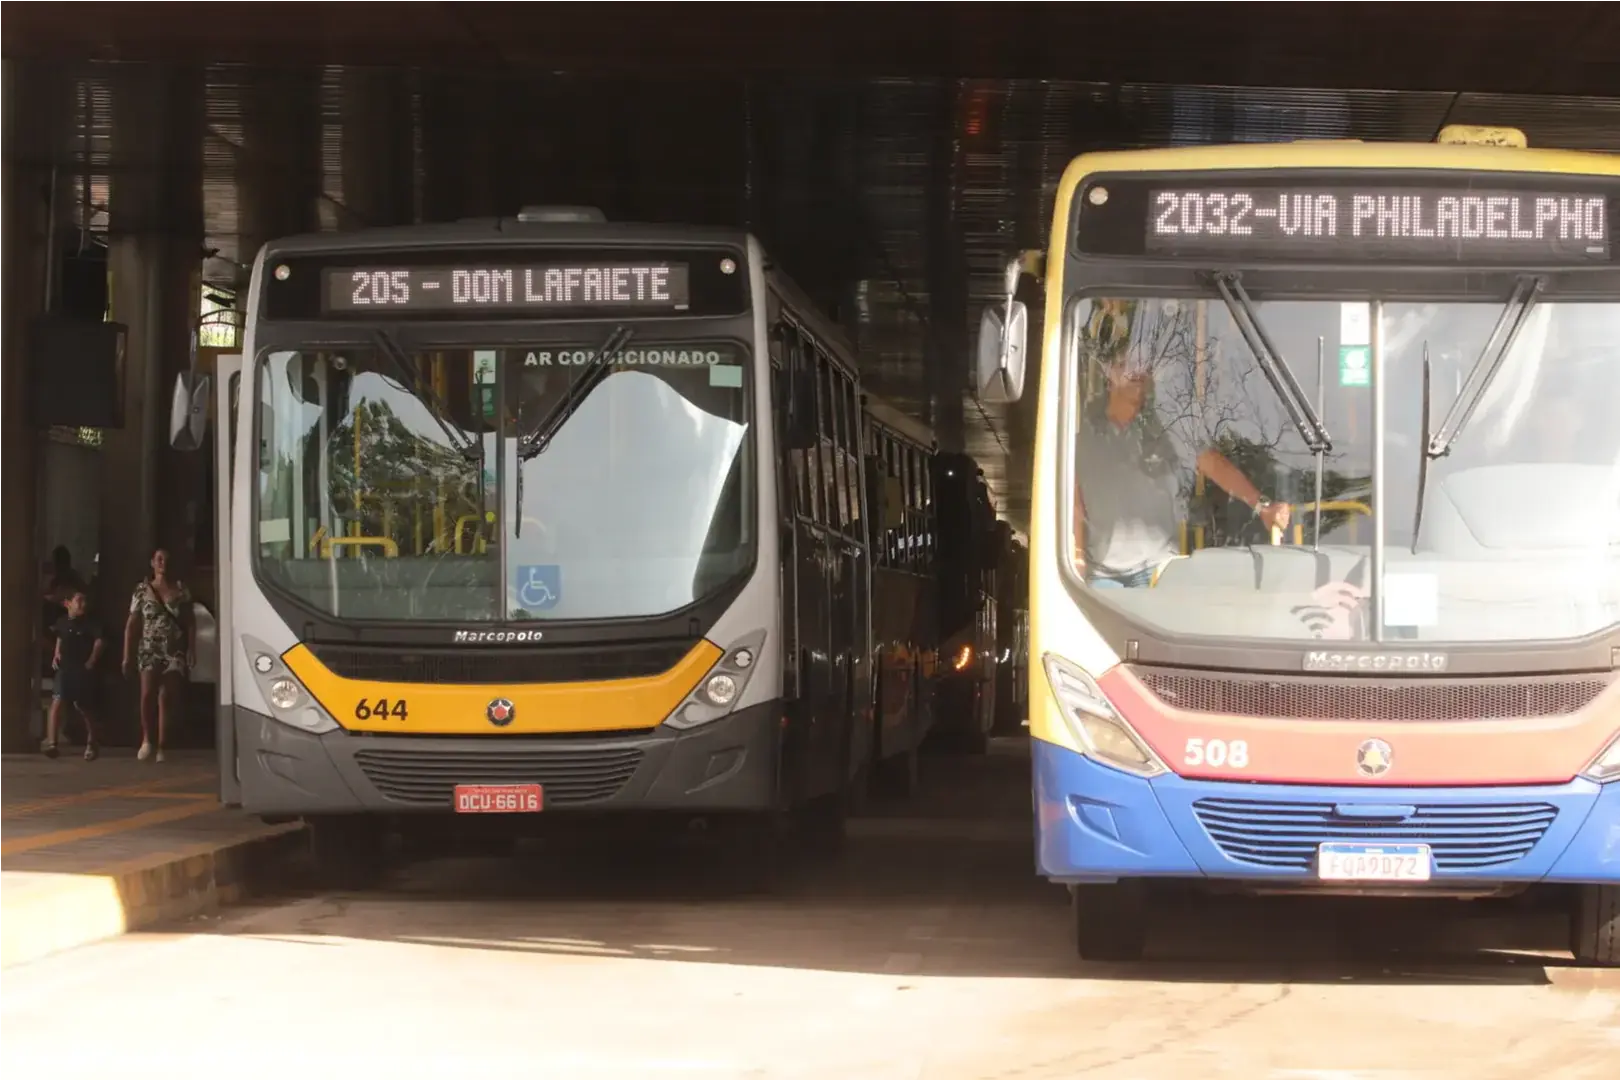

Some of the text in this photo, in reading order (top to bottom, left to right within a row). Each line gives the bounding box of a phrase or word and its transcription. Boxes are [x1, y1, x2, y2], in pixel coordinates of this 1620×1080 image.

[1156, 192, 1604, 240] 2032-VIA PHILADELPHO
[352, 271, 409, 304] 205
[452, 269, 513, 303] DOM
[525, 268, 670, 302] LAFAIETE
[524, 352, 553, 366] AR
[454, 630, 543, 643] Marcopolo
[1307, 651, 1445, 670] Marcopolo
[355, 698, 409, 721] 644
[1184, 738, 1249, 768] 508
